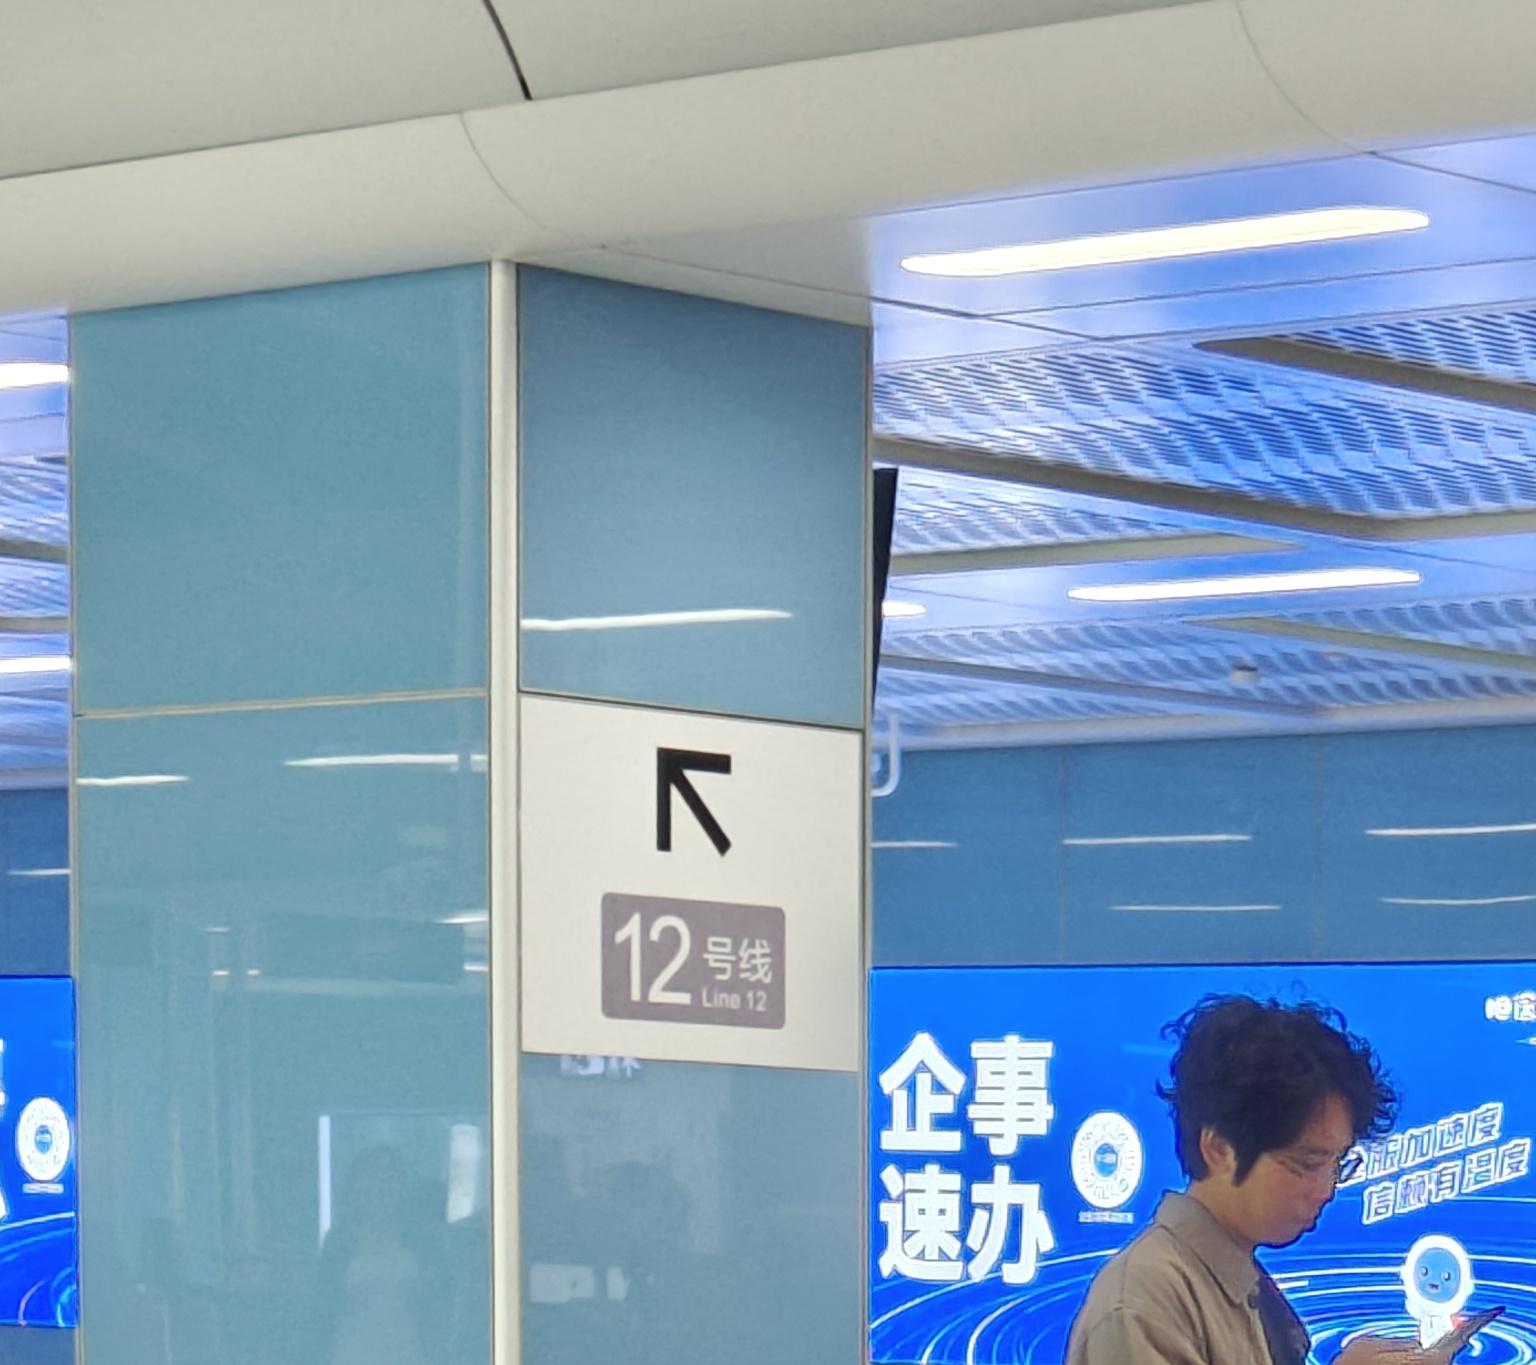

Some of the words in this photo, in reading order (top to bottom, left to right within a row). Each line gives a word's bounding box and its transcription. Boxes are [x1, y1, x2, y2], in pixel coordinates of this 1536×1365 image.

[613, 912, 691, 1005] 12
[703, 936, 772, 984] 号线
[702, 987, 741, 1009] Line
[746, 990, 767, 1012] 12
[879, 1031, 1055, 1156] 企事
[879, 1163, 1056, 1284] 速办
